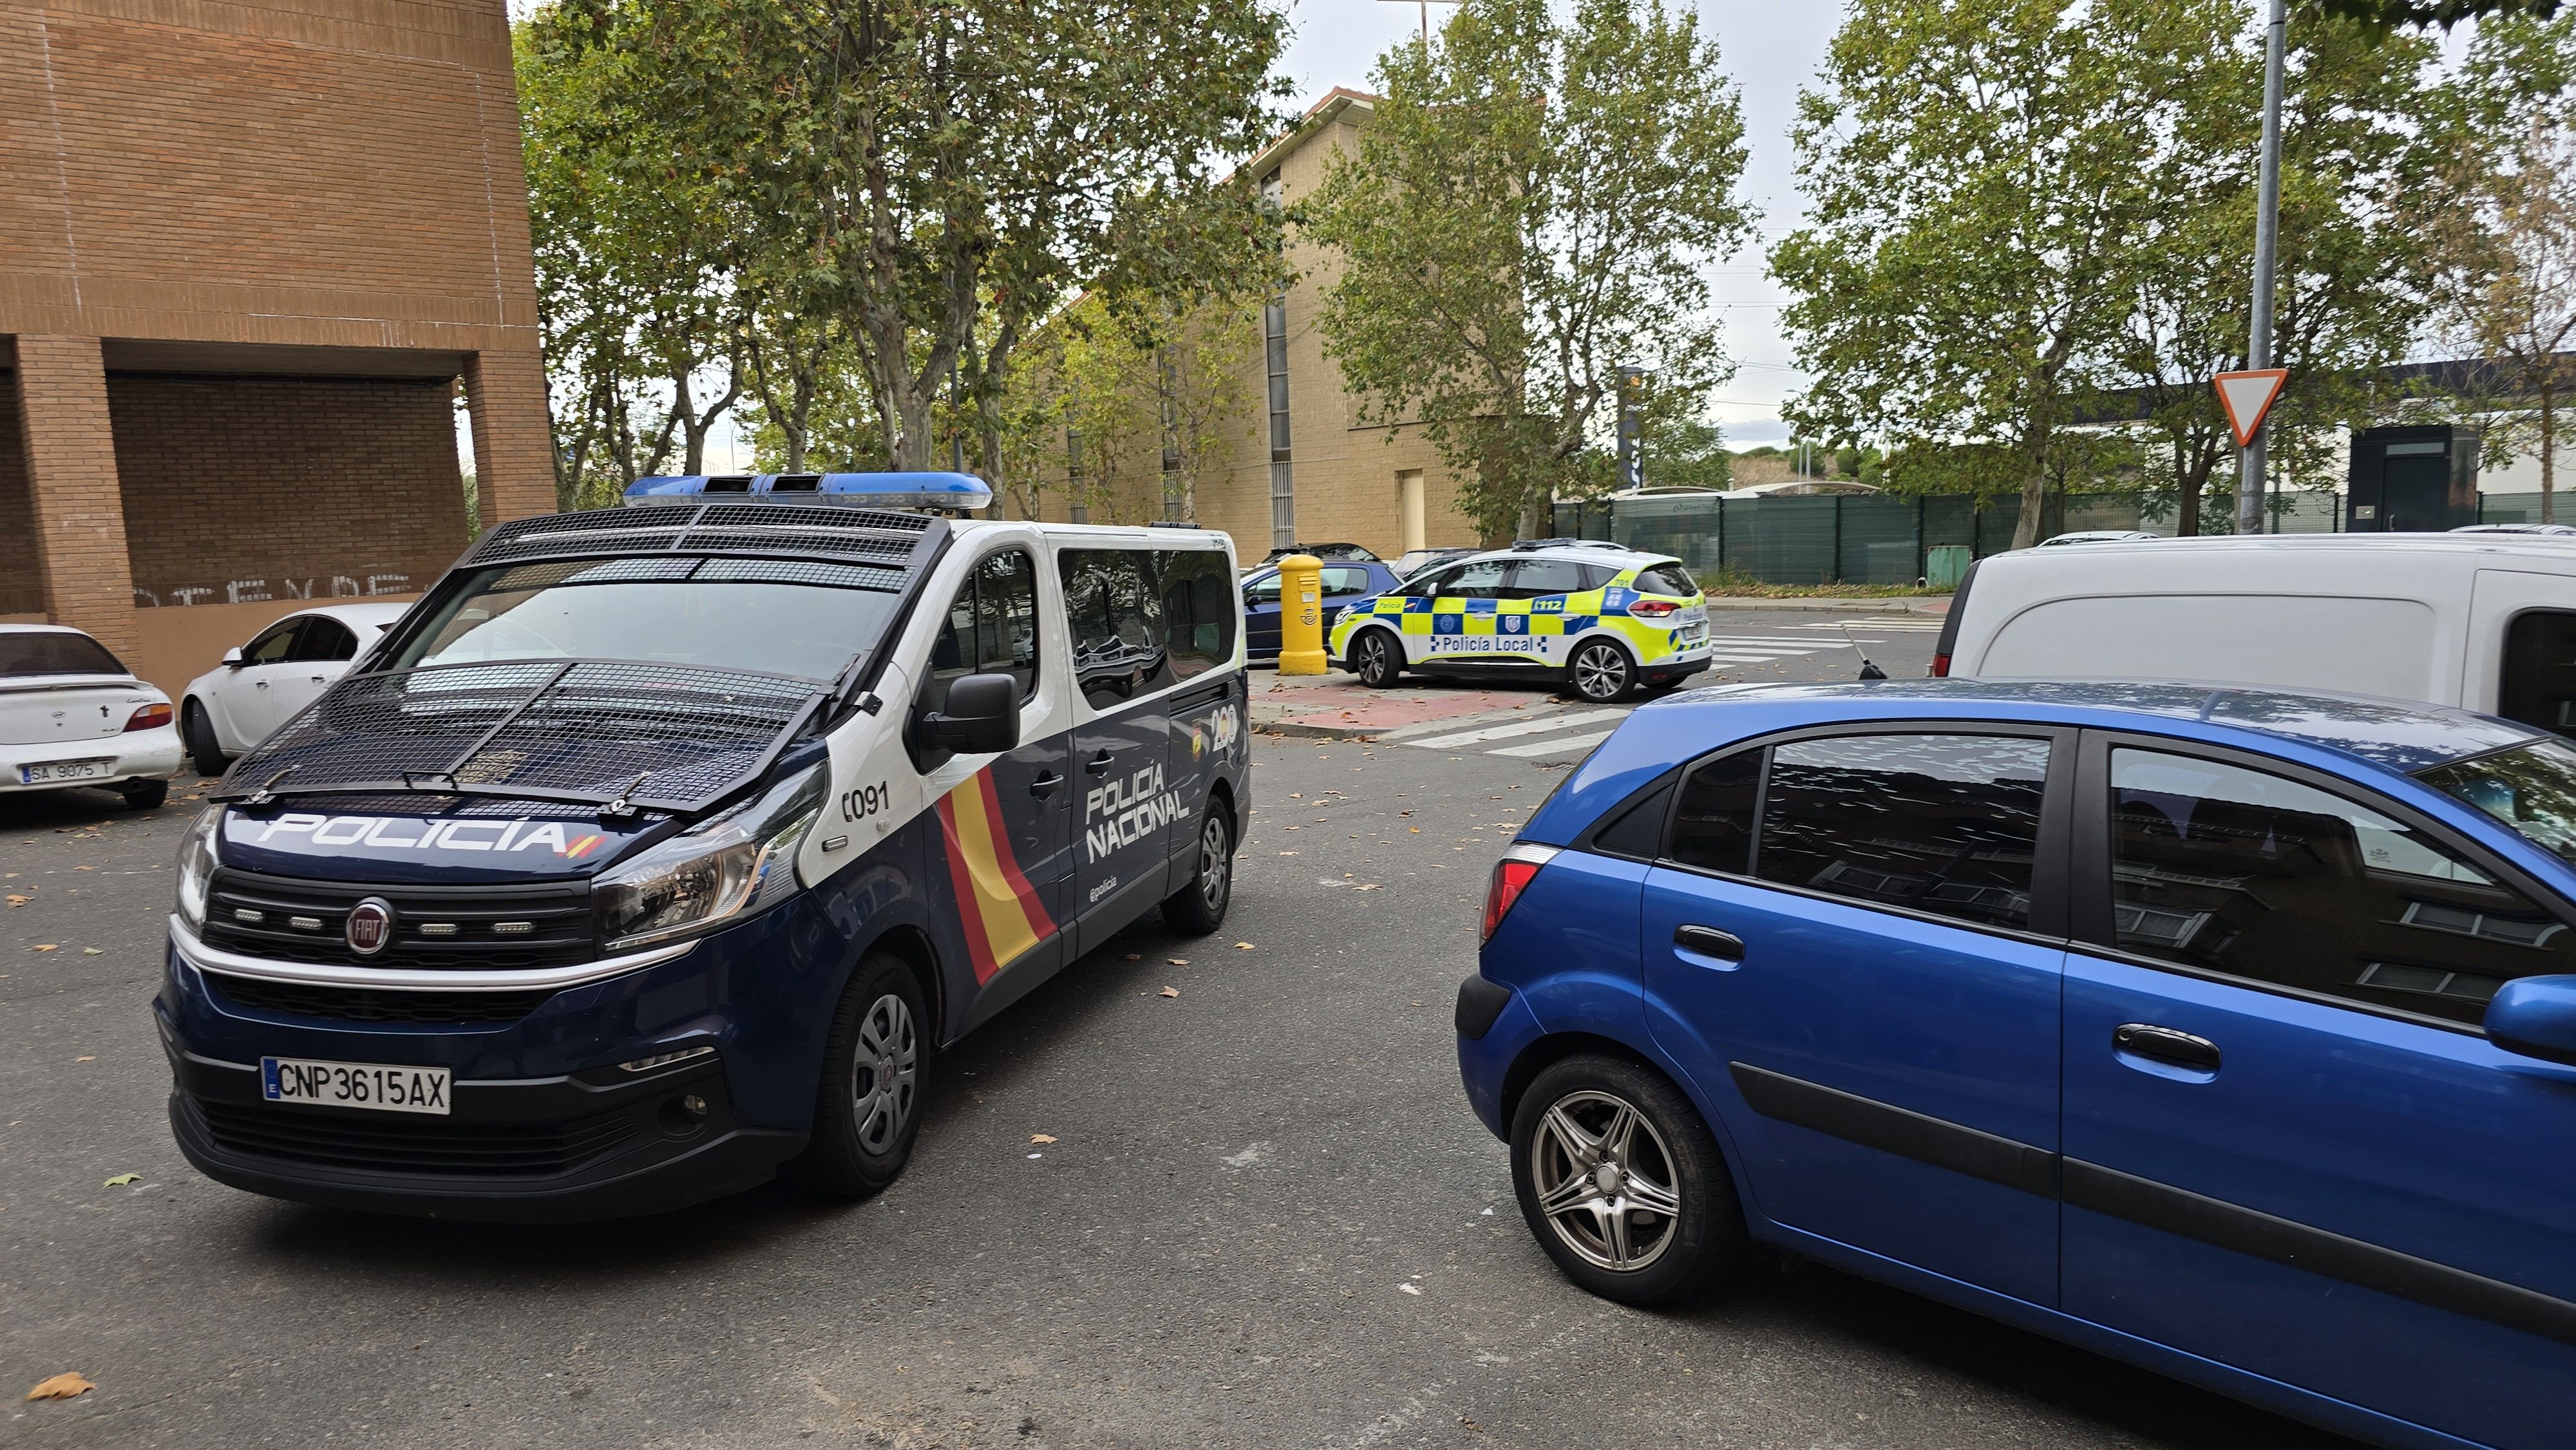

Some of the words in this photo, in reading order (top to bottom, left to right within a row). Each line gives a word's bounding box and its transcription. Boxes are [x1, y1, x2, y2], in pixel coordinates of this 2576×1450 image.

[1539, 601, 1562, 610] 112
[1443, 637, 1490, 651] Policía
[1496, 637, 1533, 651] Local
[32, 767, 50, 780] SA
[100, 762, 109, 773] T
[852, 780, 889, 819] 091
[1086, 758, 1164, 825] POLICÍA
[259, 813, 567, 852] POLICÍA
[1086, 790, 1189, 863] NACIONAL
[355, 919, 381, 940] FIAT
[269, 1084, 276, 1093] E
